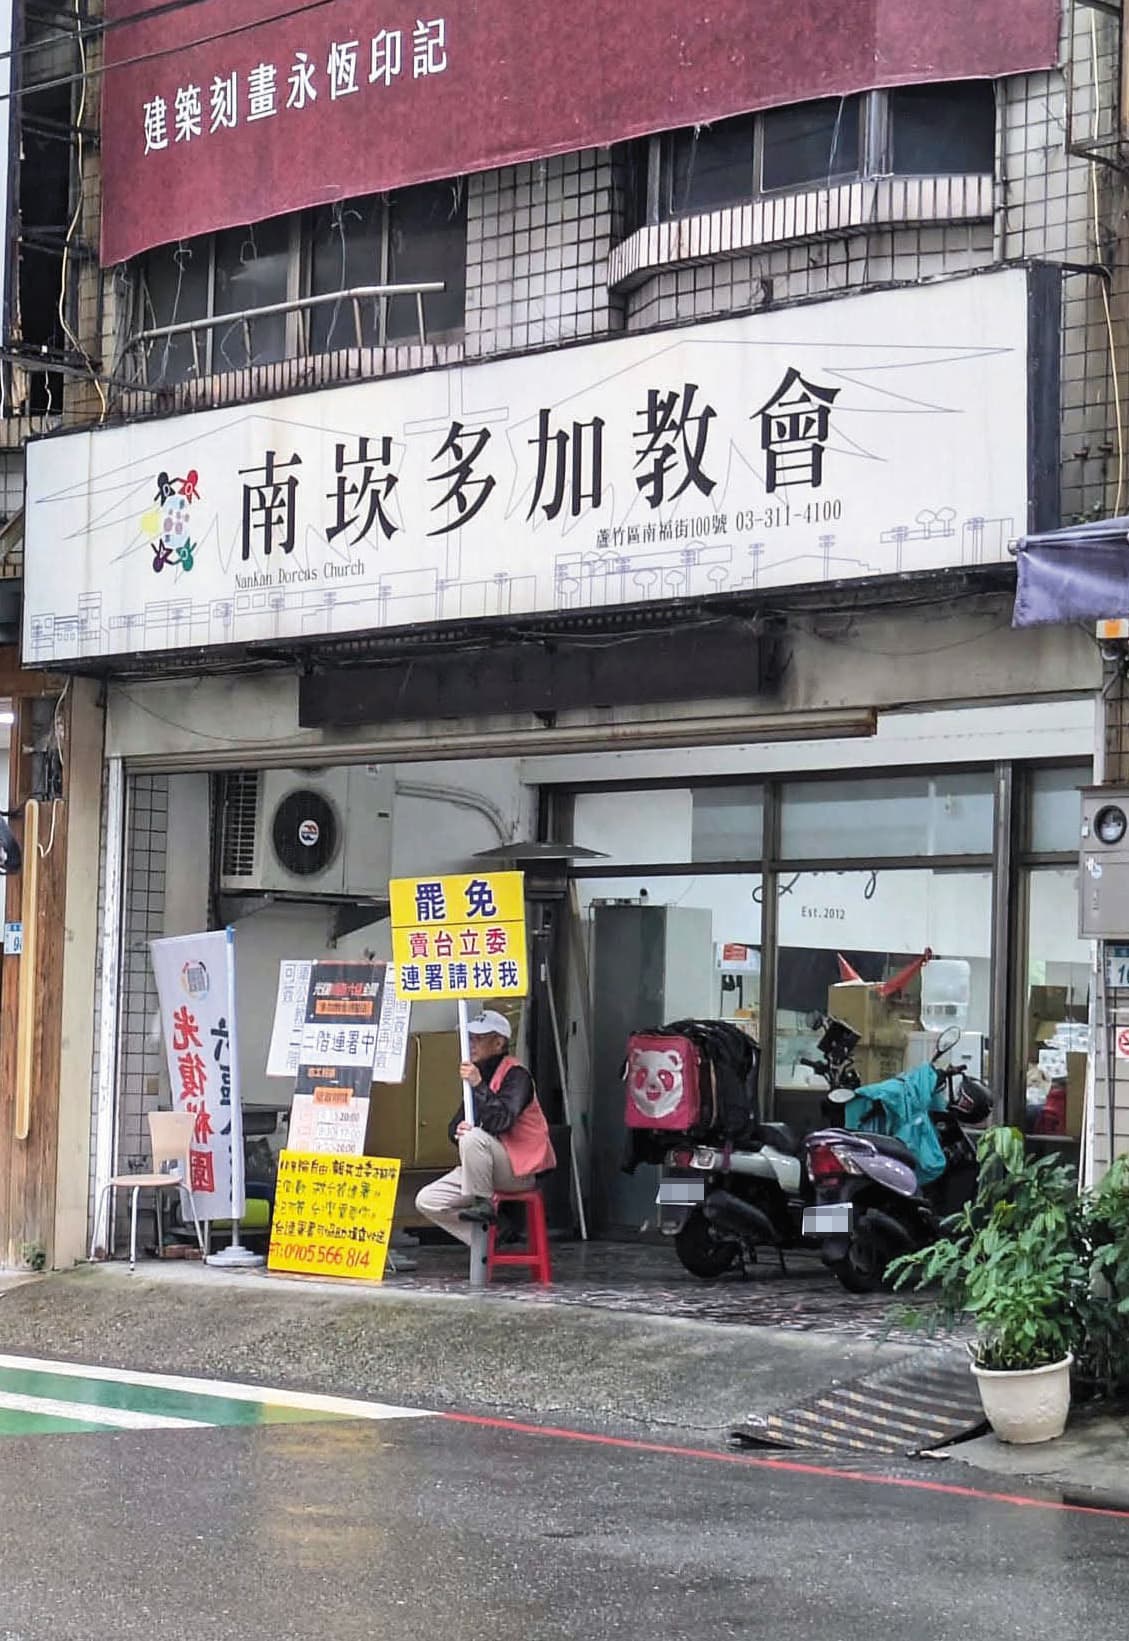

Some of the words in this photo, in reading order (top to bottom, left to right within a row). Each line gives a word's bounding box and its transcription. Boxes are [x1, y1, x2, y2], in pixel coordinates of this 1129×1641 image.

[143, 18, 447, 155] 建築刻畫永恆印記
[237, 366, 841, 561] 南崁多加教會
[596, 513, 728, 549] 蘆竹區南福街100號
[735, 499, 842, 532] 03-311-4100
[278, 567, 318, 584] Dorcas
[323, 559, 365, 579] Church
[415, 879, 497, 921] 罷免
[801, 906, 846, 920] Est.2012
[409, 928, 507, 958] 賣台立委
[401, 960, 518, 991] 連署請找我
